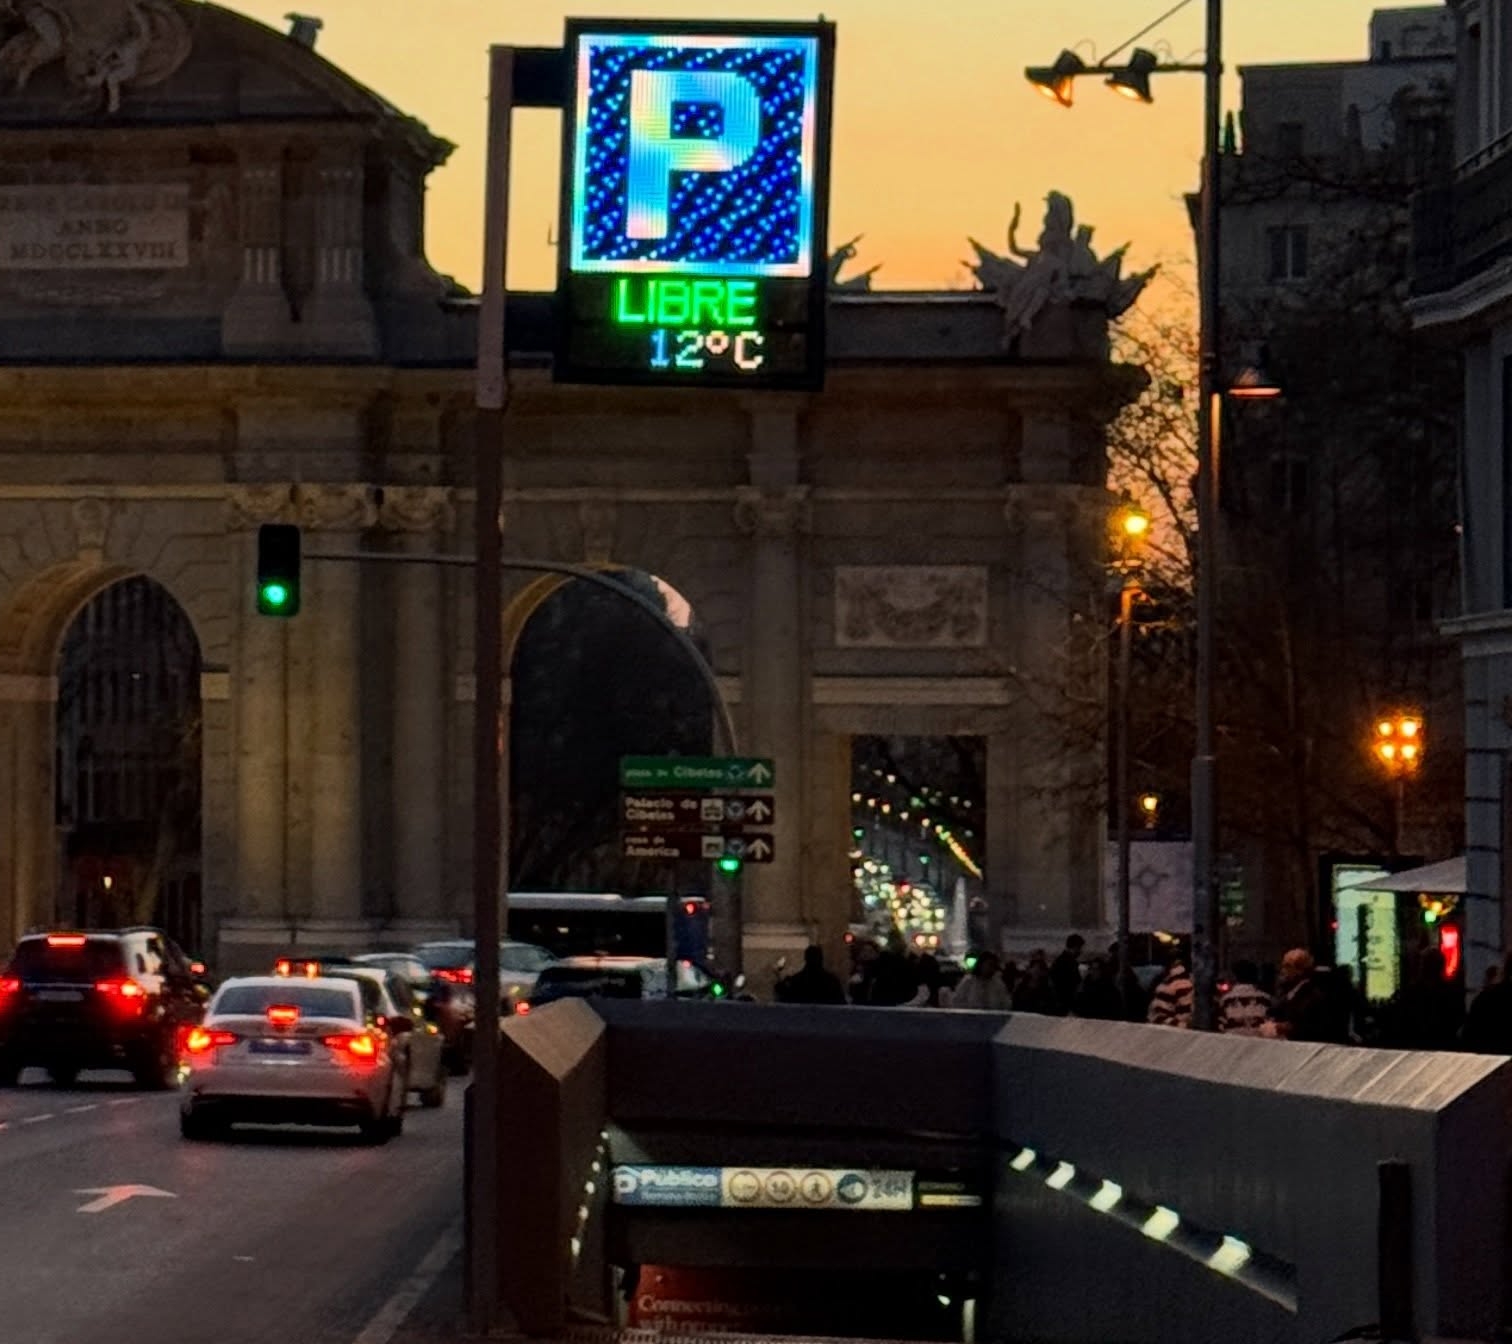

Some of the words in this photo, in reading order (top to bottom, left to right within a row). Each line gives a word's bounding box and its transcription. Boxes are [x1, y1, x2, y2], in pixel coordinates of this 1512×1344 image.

[626, 69, 760, 239] P
[617, 279, 758, 325] LIBRE
[673, 765, 724, 778] Cibeles
[625, 797, 674, 809] Palacio
[680, 798, 698, 810] de
[625, 809, 675, 821] Cibeles
